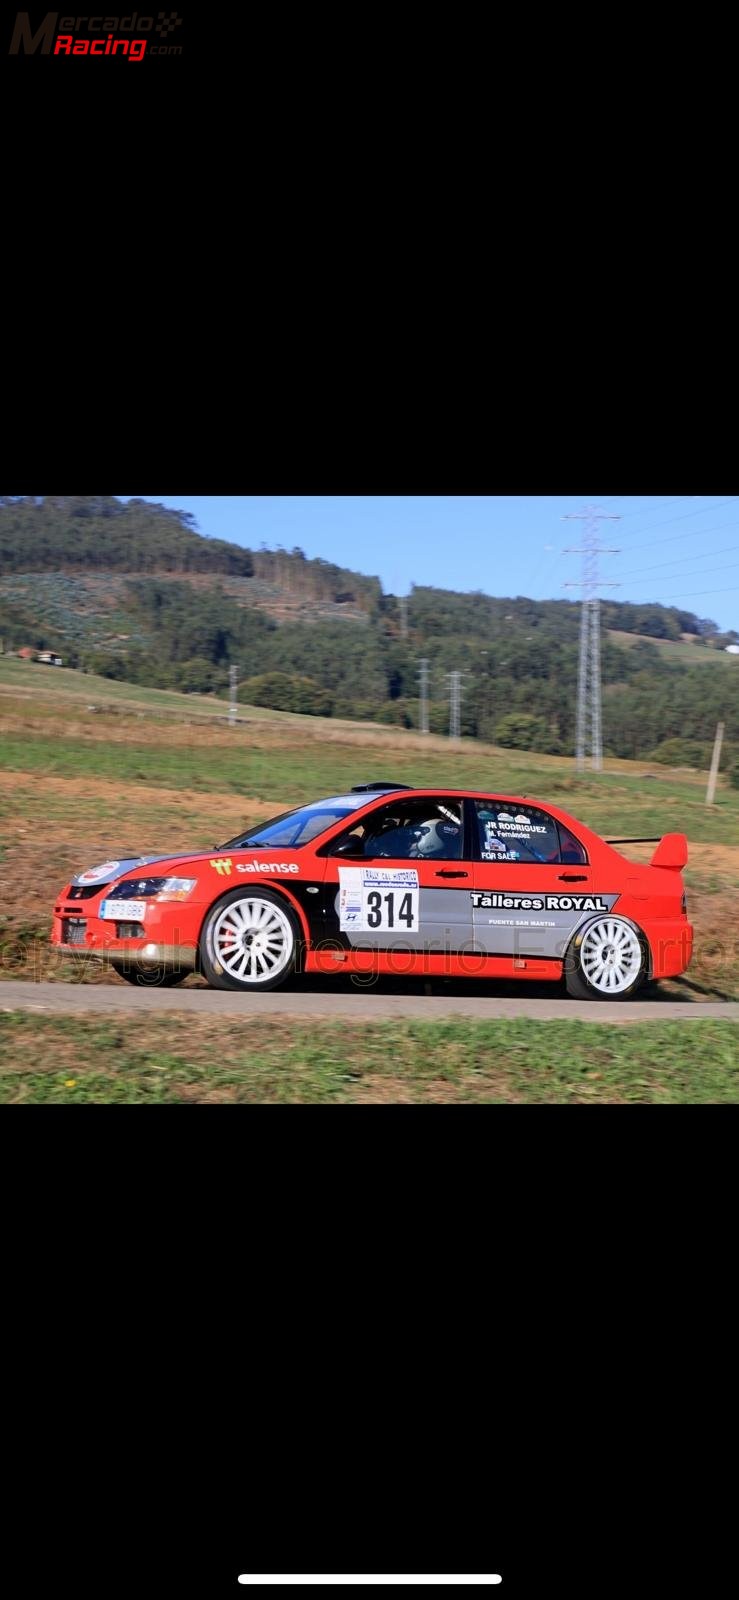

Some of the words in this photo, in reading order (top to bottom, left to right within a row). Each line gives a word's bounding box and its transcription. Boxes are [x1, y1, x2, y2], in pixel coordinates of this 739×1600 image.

[498, 822, 547, 834] RODRIGUEZ
[481, 852, 496, 860] FOR
[235, 859, 300, 874] salense
[367, 891, 414, 928] 314
[471, 893, 543, 909] Talleres
[546, 897, 608, 911] ROYAL
